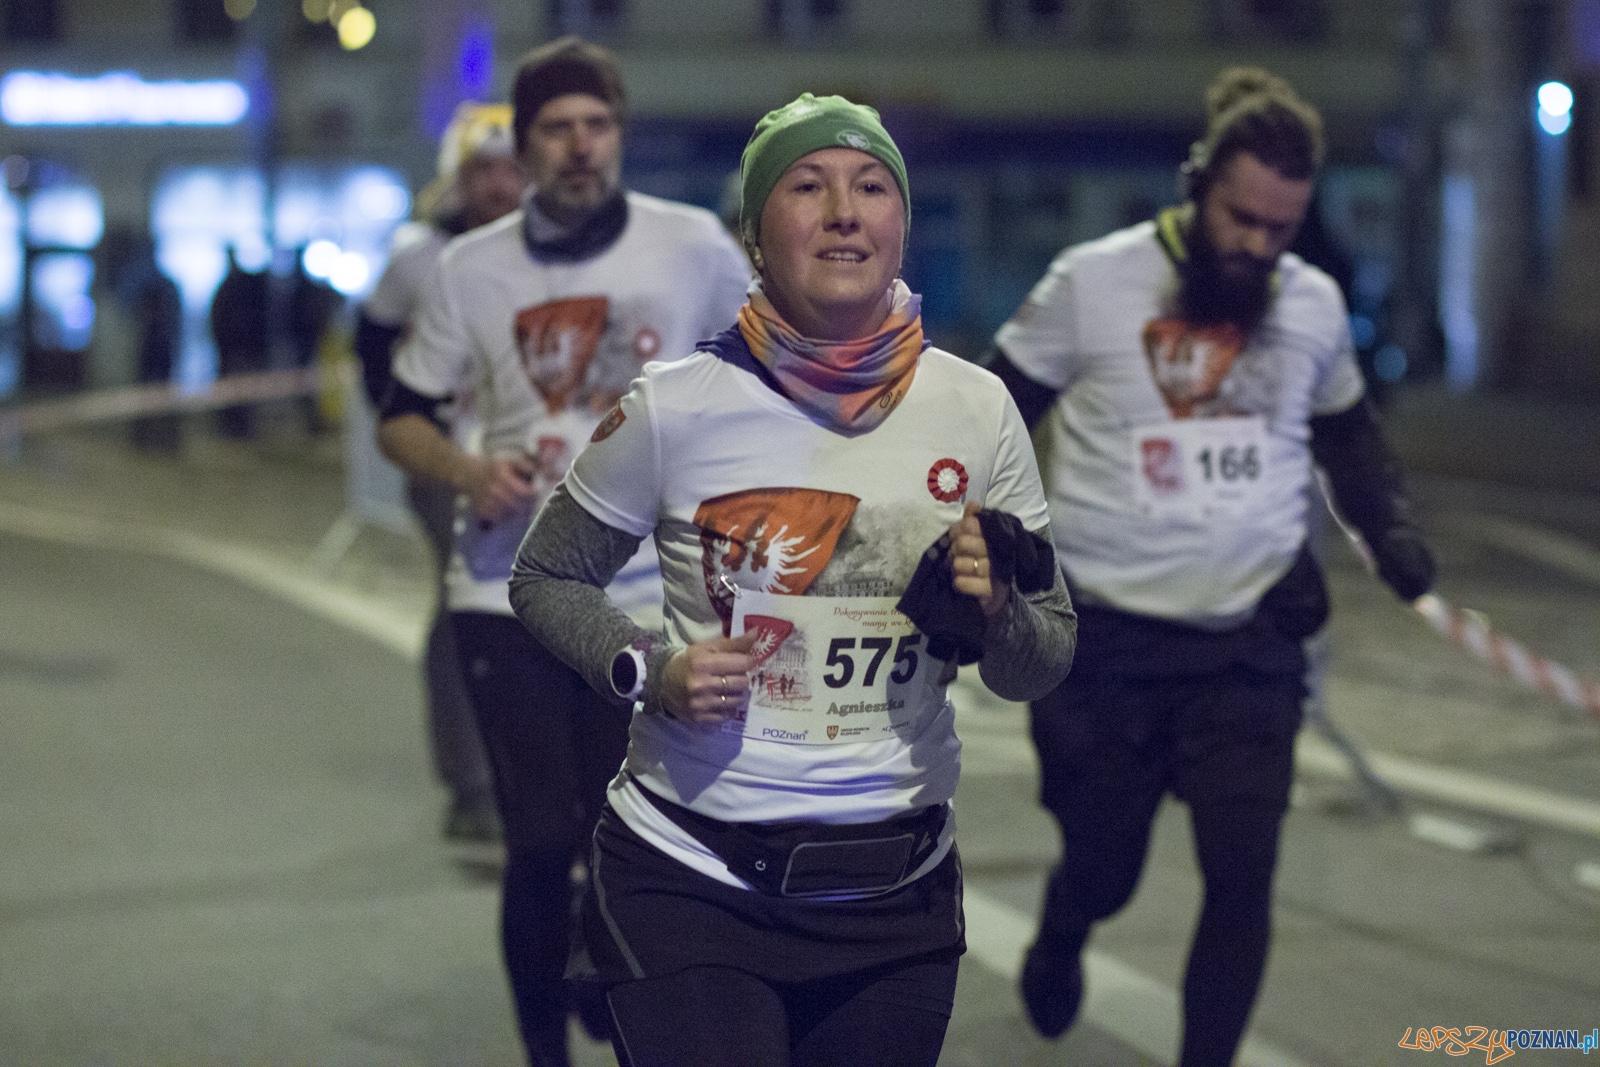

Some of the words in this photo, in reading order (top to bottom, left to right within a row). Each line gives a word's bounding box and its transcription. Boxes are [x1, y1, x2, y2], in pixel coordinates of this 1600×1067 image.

[1197, 445, 1261, 482] 166
[833, 606, 888, 622] Pokonywanie
[862, 620, 888, 632] mamy
[890, 619, 902, 627] we
[822, 633, 922, 689] 575
[826, 699, 905, 717] Agnieszka
